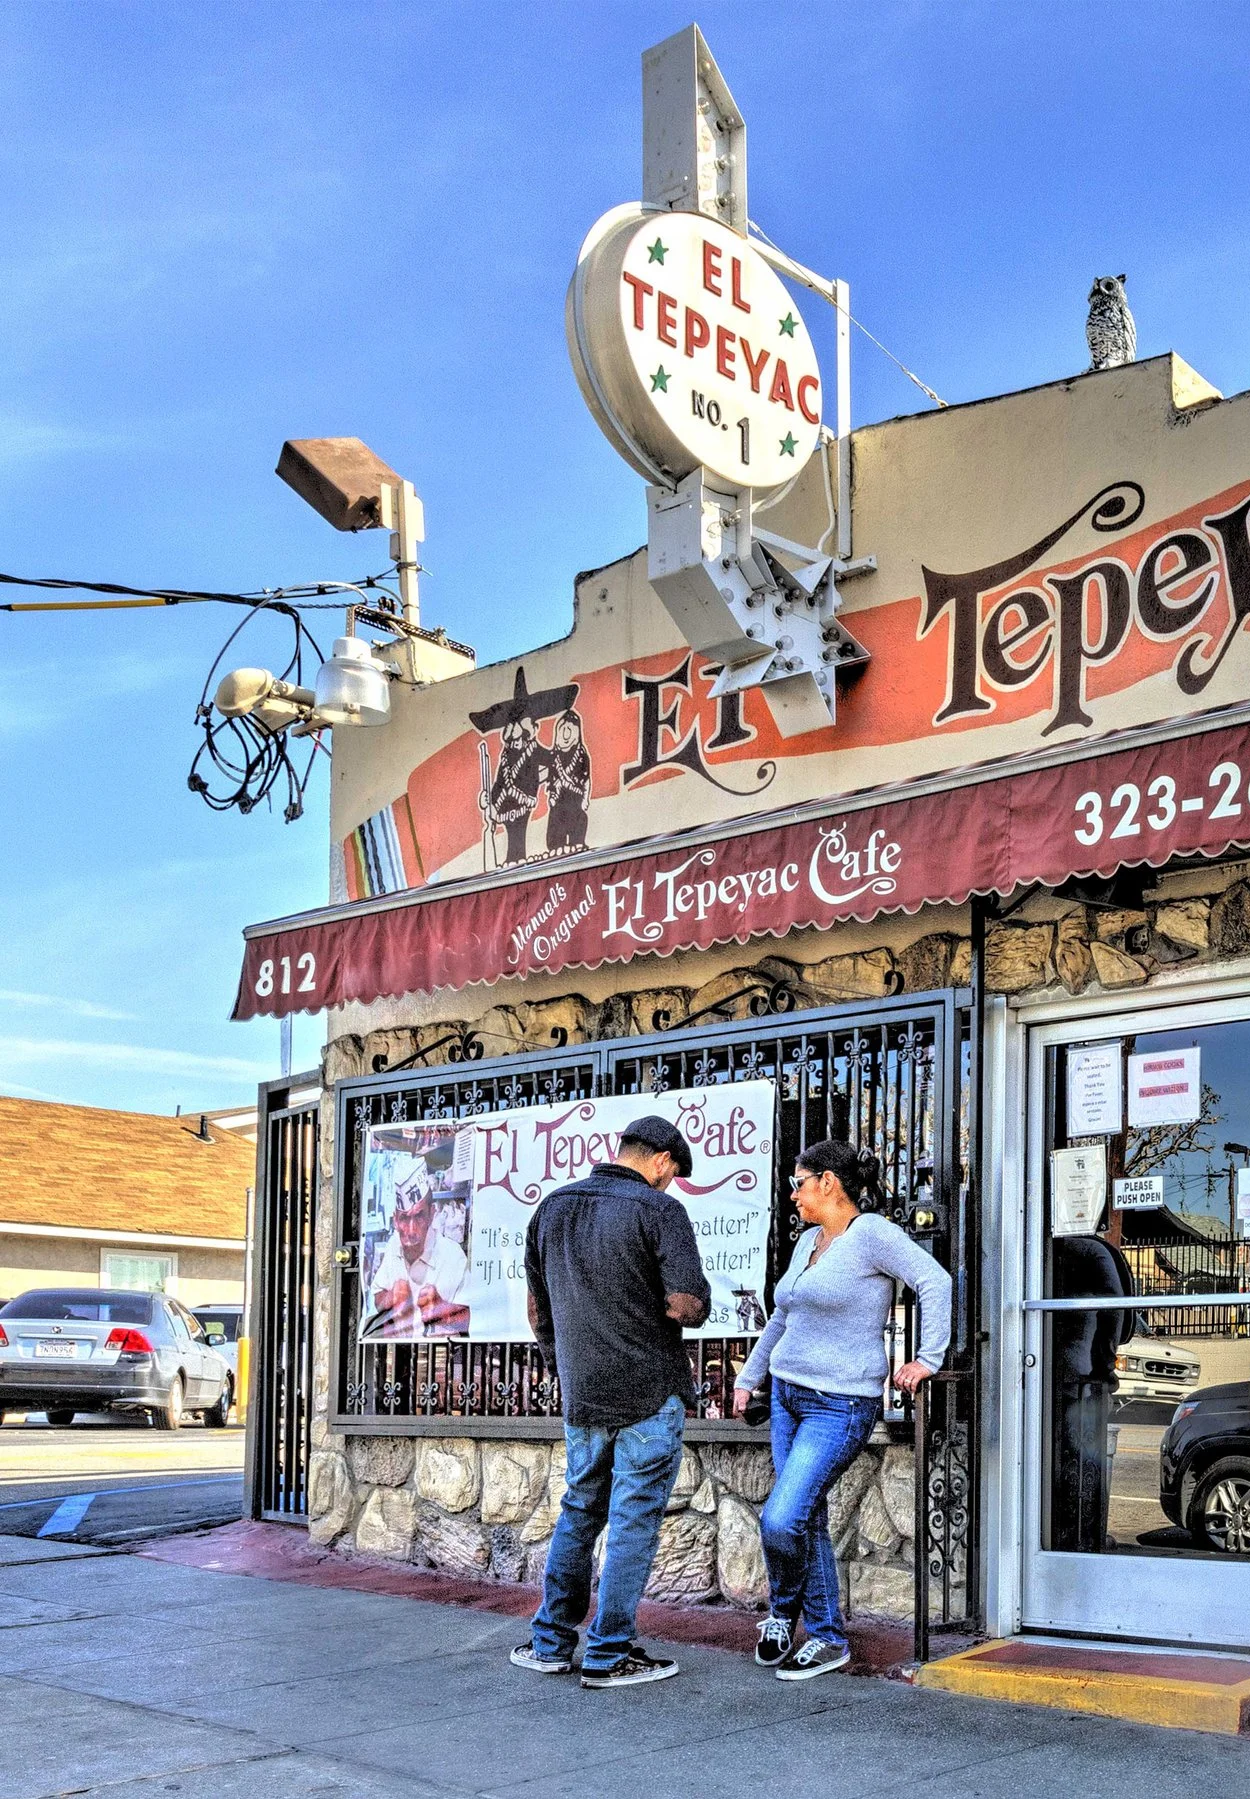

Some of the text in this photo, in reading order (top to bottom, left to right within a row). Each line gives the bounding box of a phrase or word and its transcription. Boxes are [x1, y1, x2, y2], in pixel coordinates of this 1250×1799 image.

[703, 239, 751, 314] EL
[623, 271, 820, 425] TEPEYAC
[691, 389, 750, 465] NO. 1
[602, 821, 902, 943] El Tepeyac Cafe
[507, 882, 567, 964] Manuel's
[533, 884, 597, 961] Original
[255, 952, 316, 997] 812
[476, 1120, 542, 1206] El
[1117, 1191, 1161, 1205] PUSH OPEN
[1124, 1180, 1153, 1192] PLEASE
